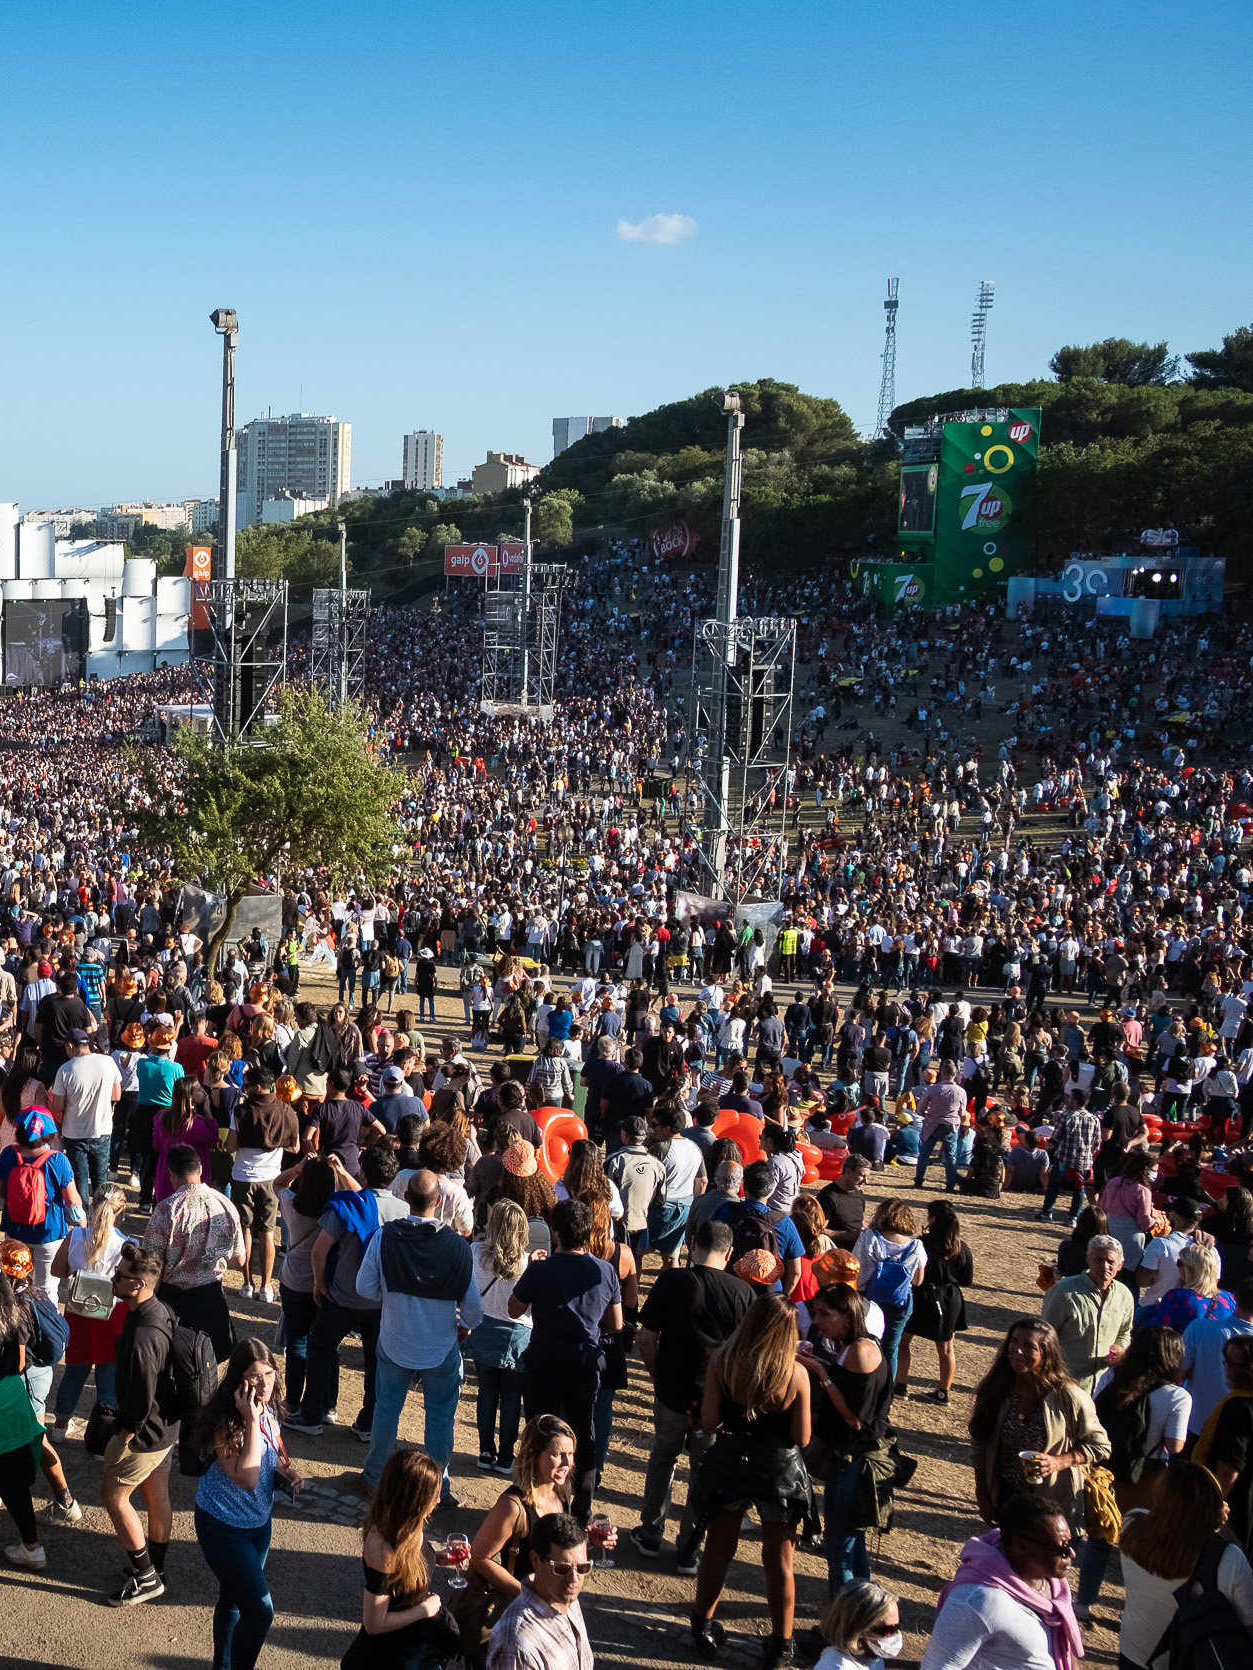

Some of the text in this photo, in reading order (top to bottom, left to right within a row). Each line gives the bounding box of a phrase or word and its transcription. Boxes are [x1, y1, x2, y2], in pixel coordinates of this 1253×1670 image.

[1010, 424, 1030, 441] up
[978, 518, 1000, 528] free
[660, 535, 684, 553] BOCK
[450, 553, 470, 568] galp
[194, 569, 210, 578] galp
